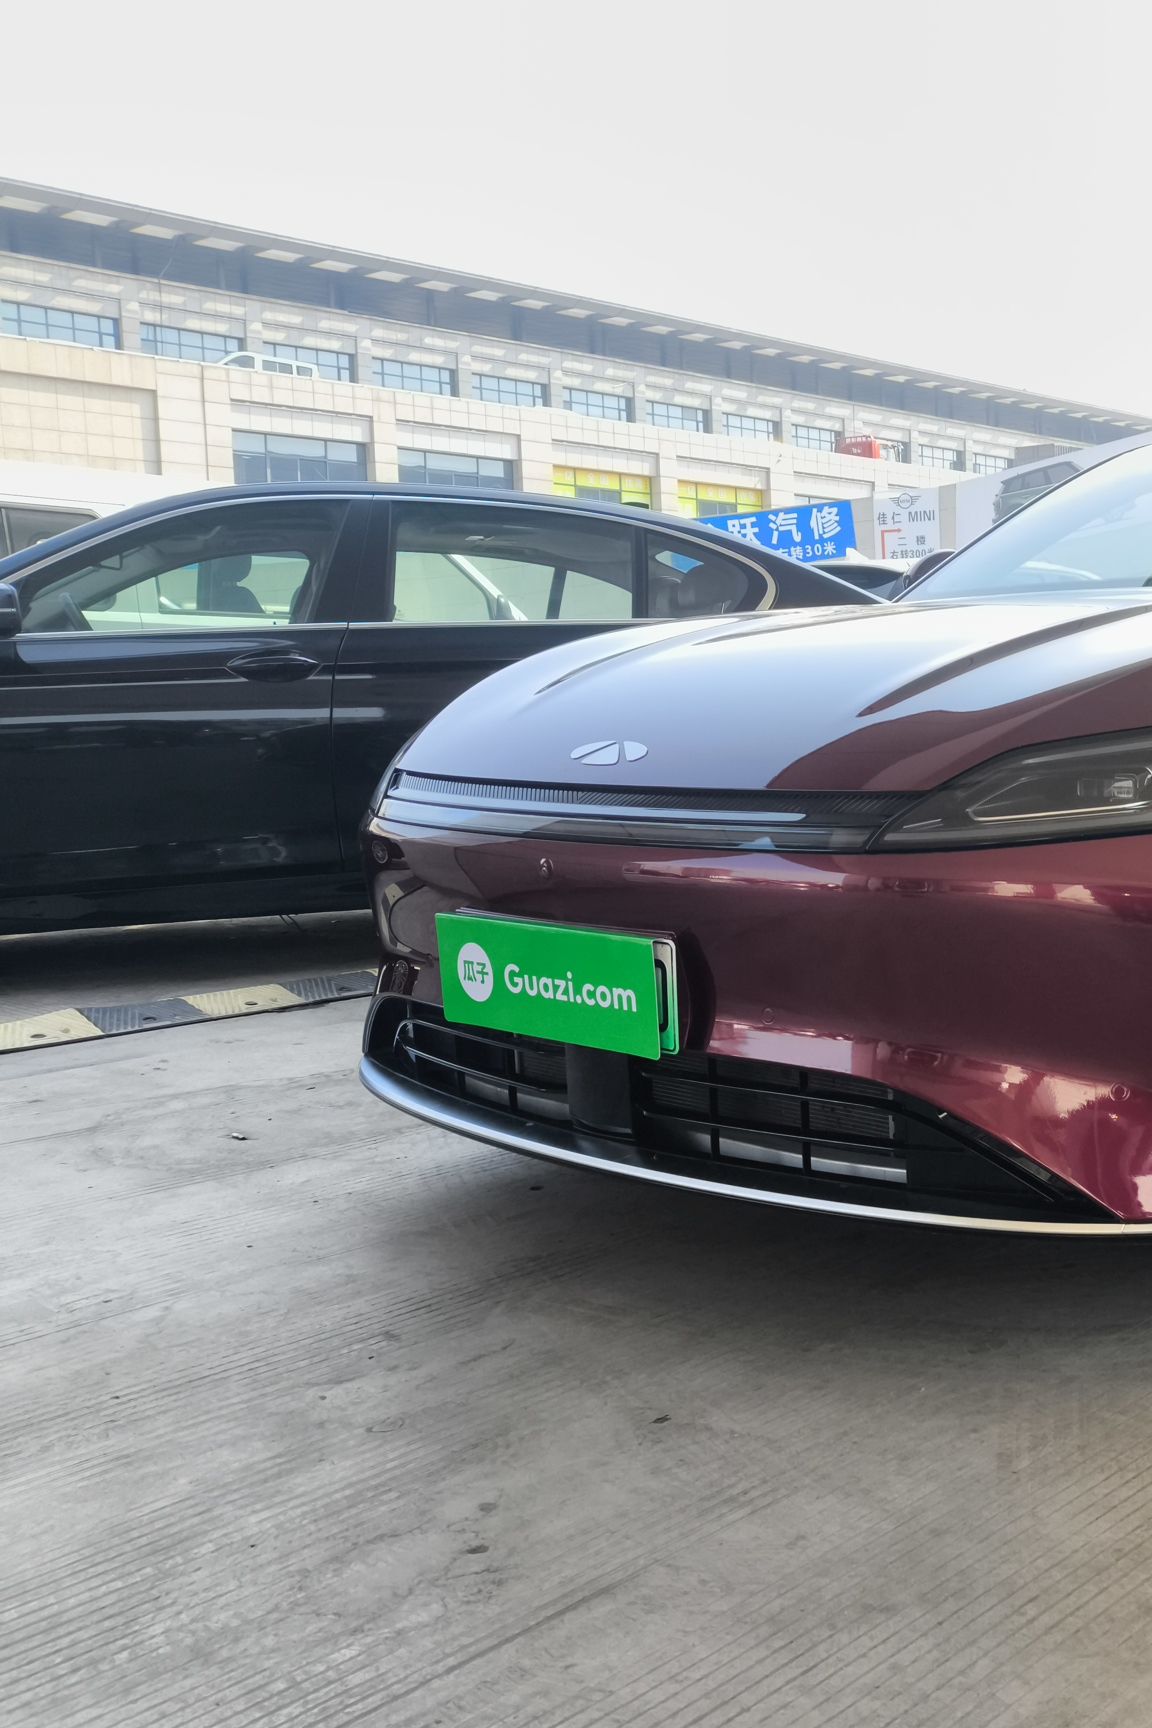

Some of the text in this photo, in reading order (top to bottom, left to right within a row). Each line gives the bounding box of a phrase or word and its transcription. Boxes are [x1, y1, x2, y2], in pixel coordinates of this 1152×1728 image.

[707, 506, 842, 545] 跃汽修
[878, 509, 936, 526] 佳仁 MINI
[463, 960, 638, 1012] 瓜子 Guazi.com
